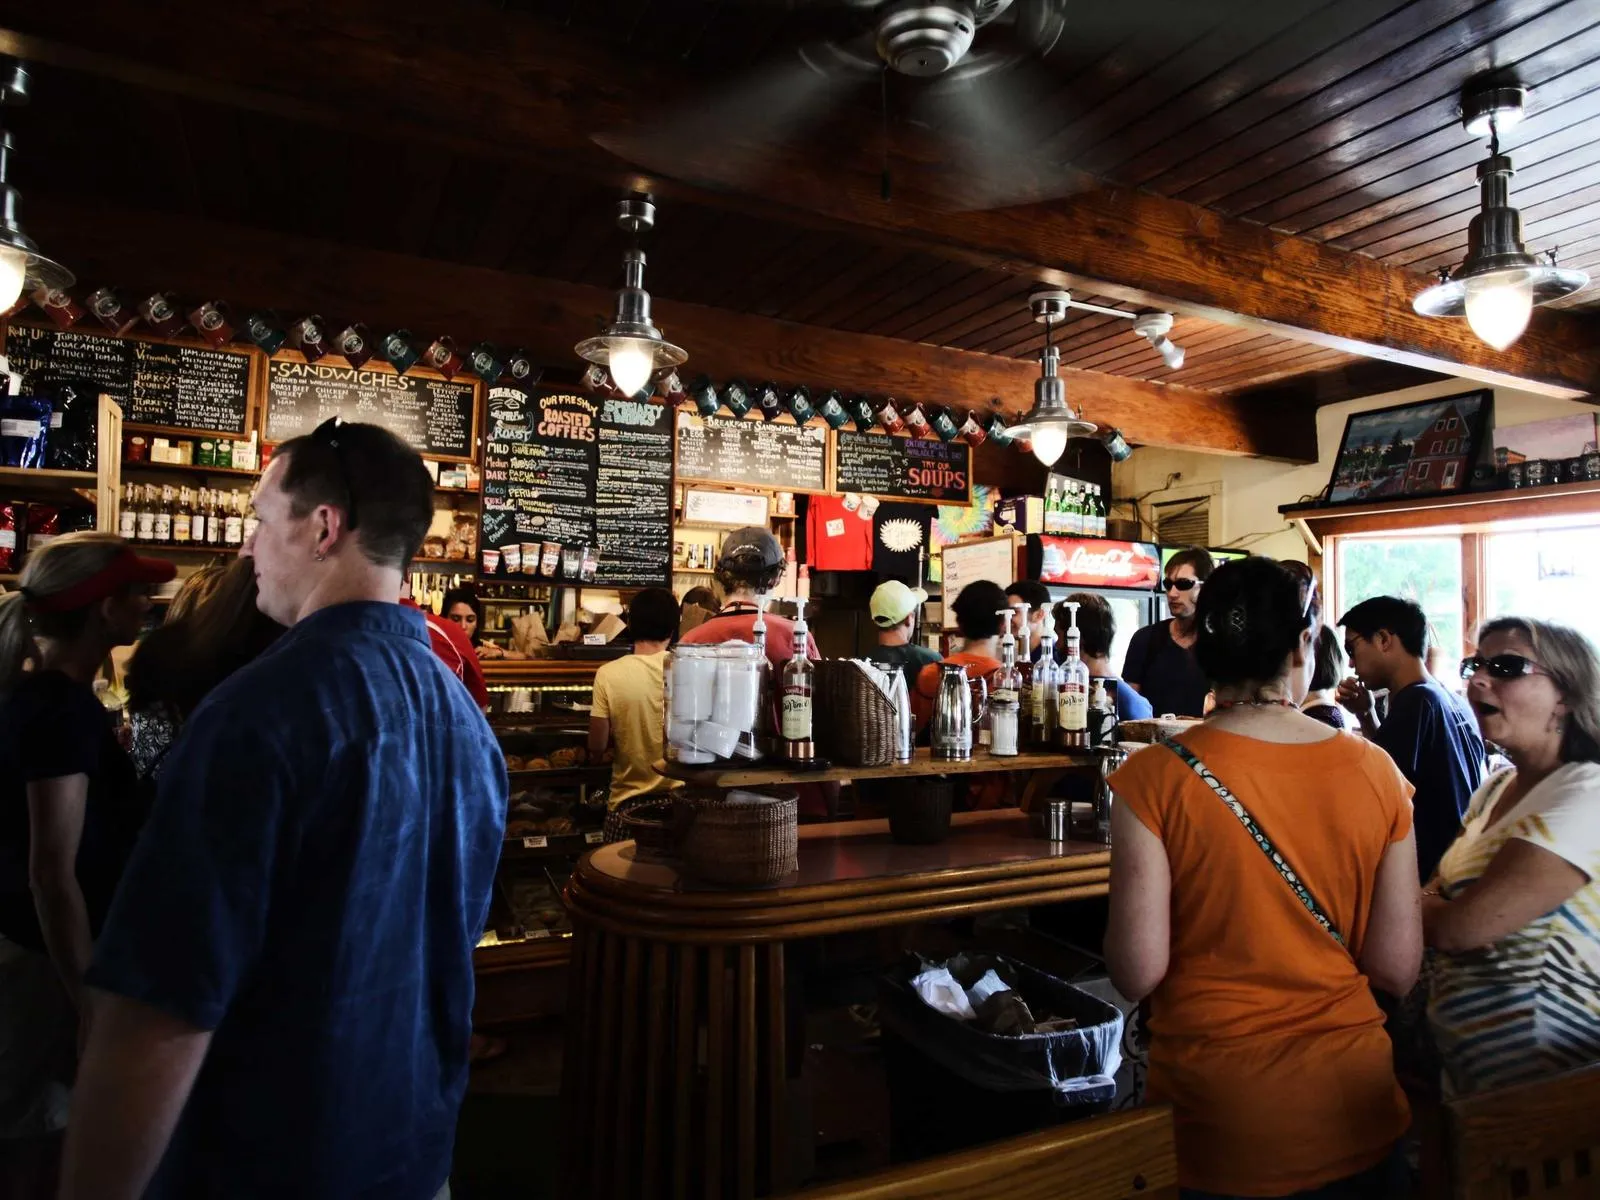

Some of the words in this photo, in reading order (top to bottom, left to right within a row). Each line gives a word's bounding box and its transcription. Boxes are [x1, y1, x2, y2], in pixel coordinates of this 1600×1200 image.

[277, 362, 410, 390] SANDWICHES
[540, 395, 557, 409] OUR
[558, 395, 599, 418] FRESHLY
[543, 408, 591, 428] ROASTED
[707, 416, 753, 430] BREAKFAST
[754, 420, 802, 434] SANDWICHES
[537, 422, 596, 442] COFFEES
[487, 442, 509, 454] MILD
[922, 460, 936, 468] TRY
[485, 470, 507, 480] DARK
[508, 469, 535, 479] PAPUA
[908, 467, 966, 490] SOUPS
[508, 488, 531, 498] PERU
